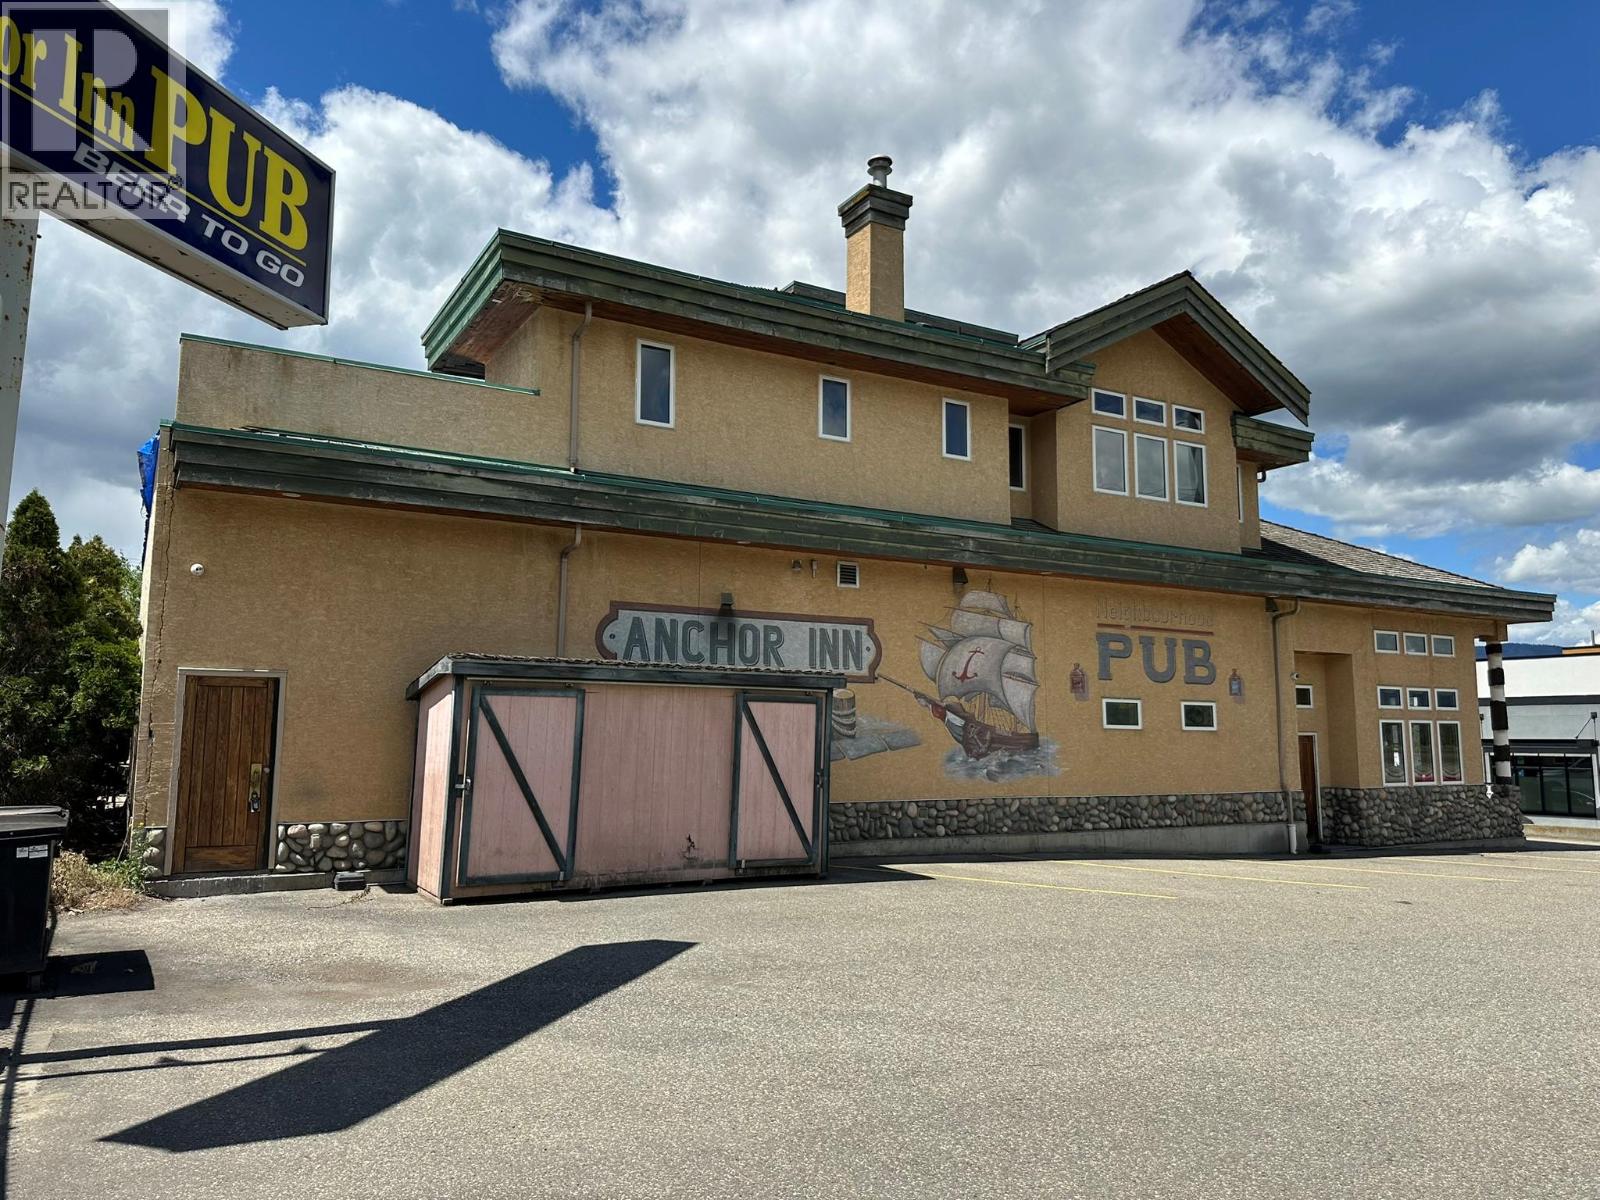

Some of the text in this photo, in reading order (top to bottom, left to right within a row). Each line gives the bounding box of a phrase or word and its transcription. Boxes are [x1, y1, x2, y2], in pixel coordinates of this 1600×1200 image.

[58, 33, 137, 151] Inn
[143, 65, 309, 251] PUB
[73, 142, 305, 288] BEER TO GO
[622, 616, 864, 671] ANCHOR INN
[1096, 632, 1217, 685] PUB
